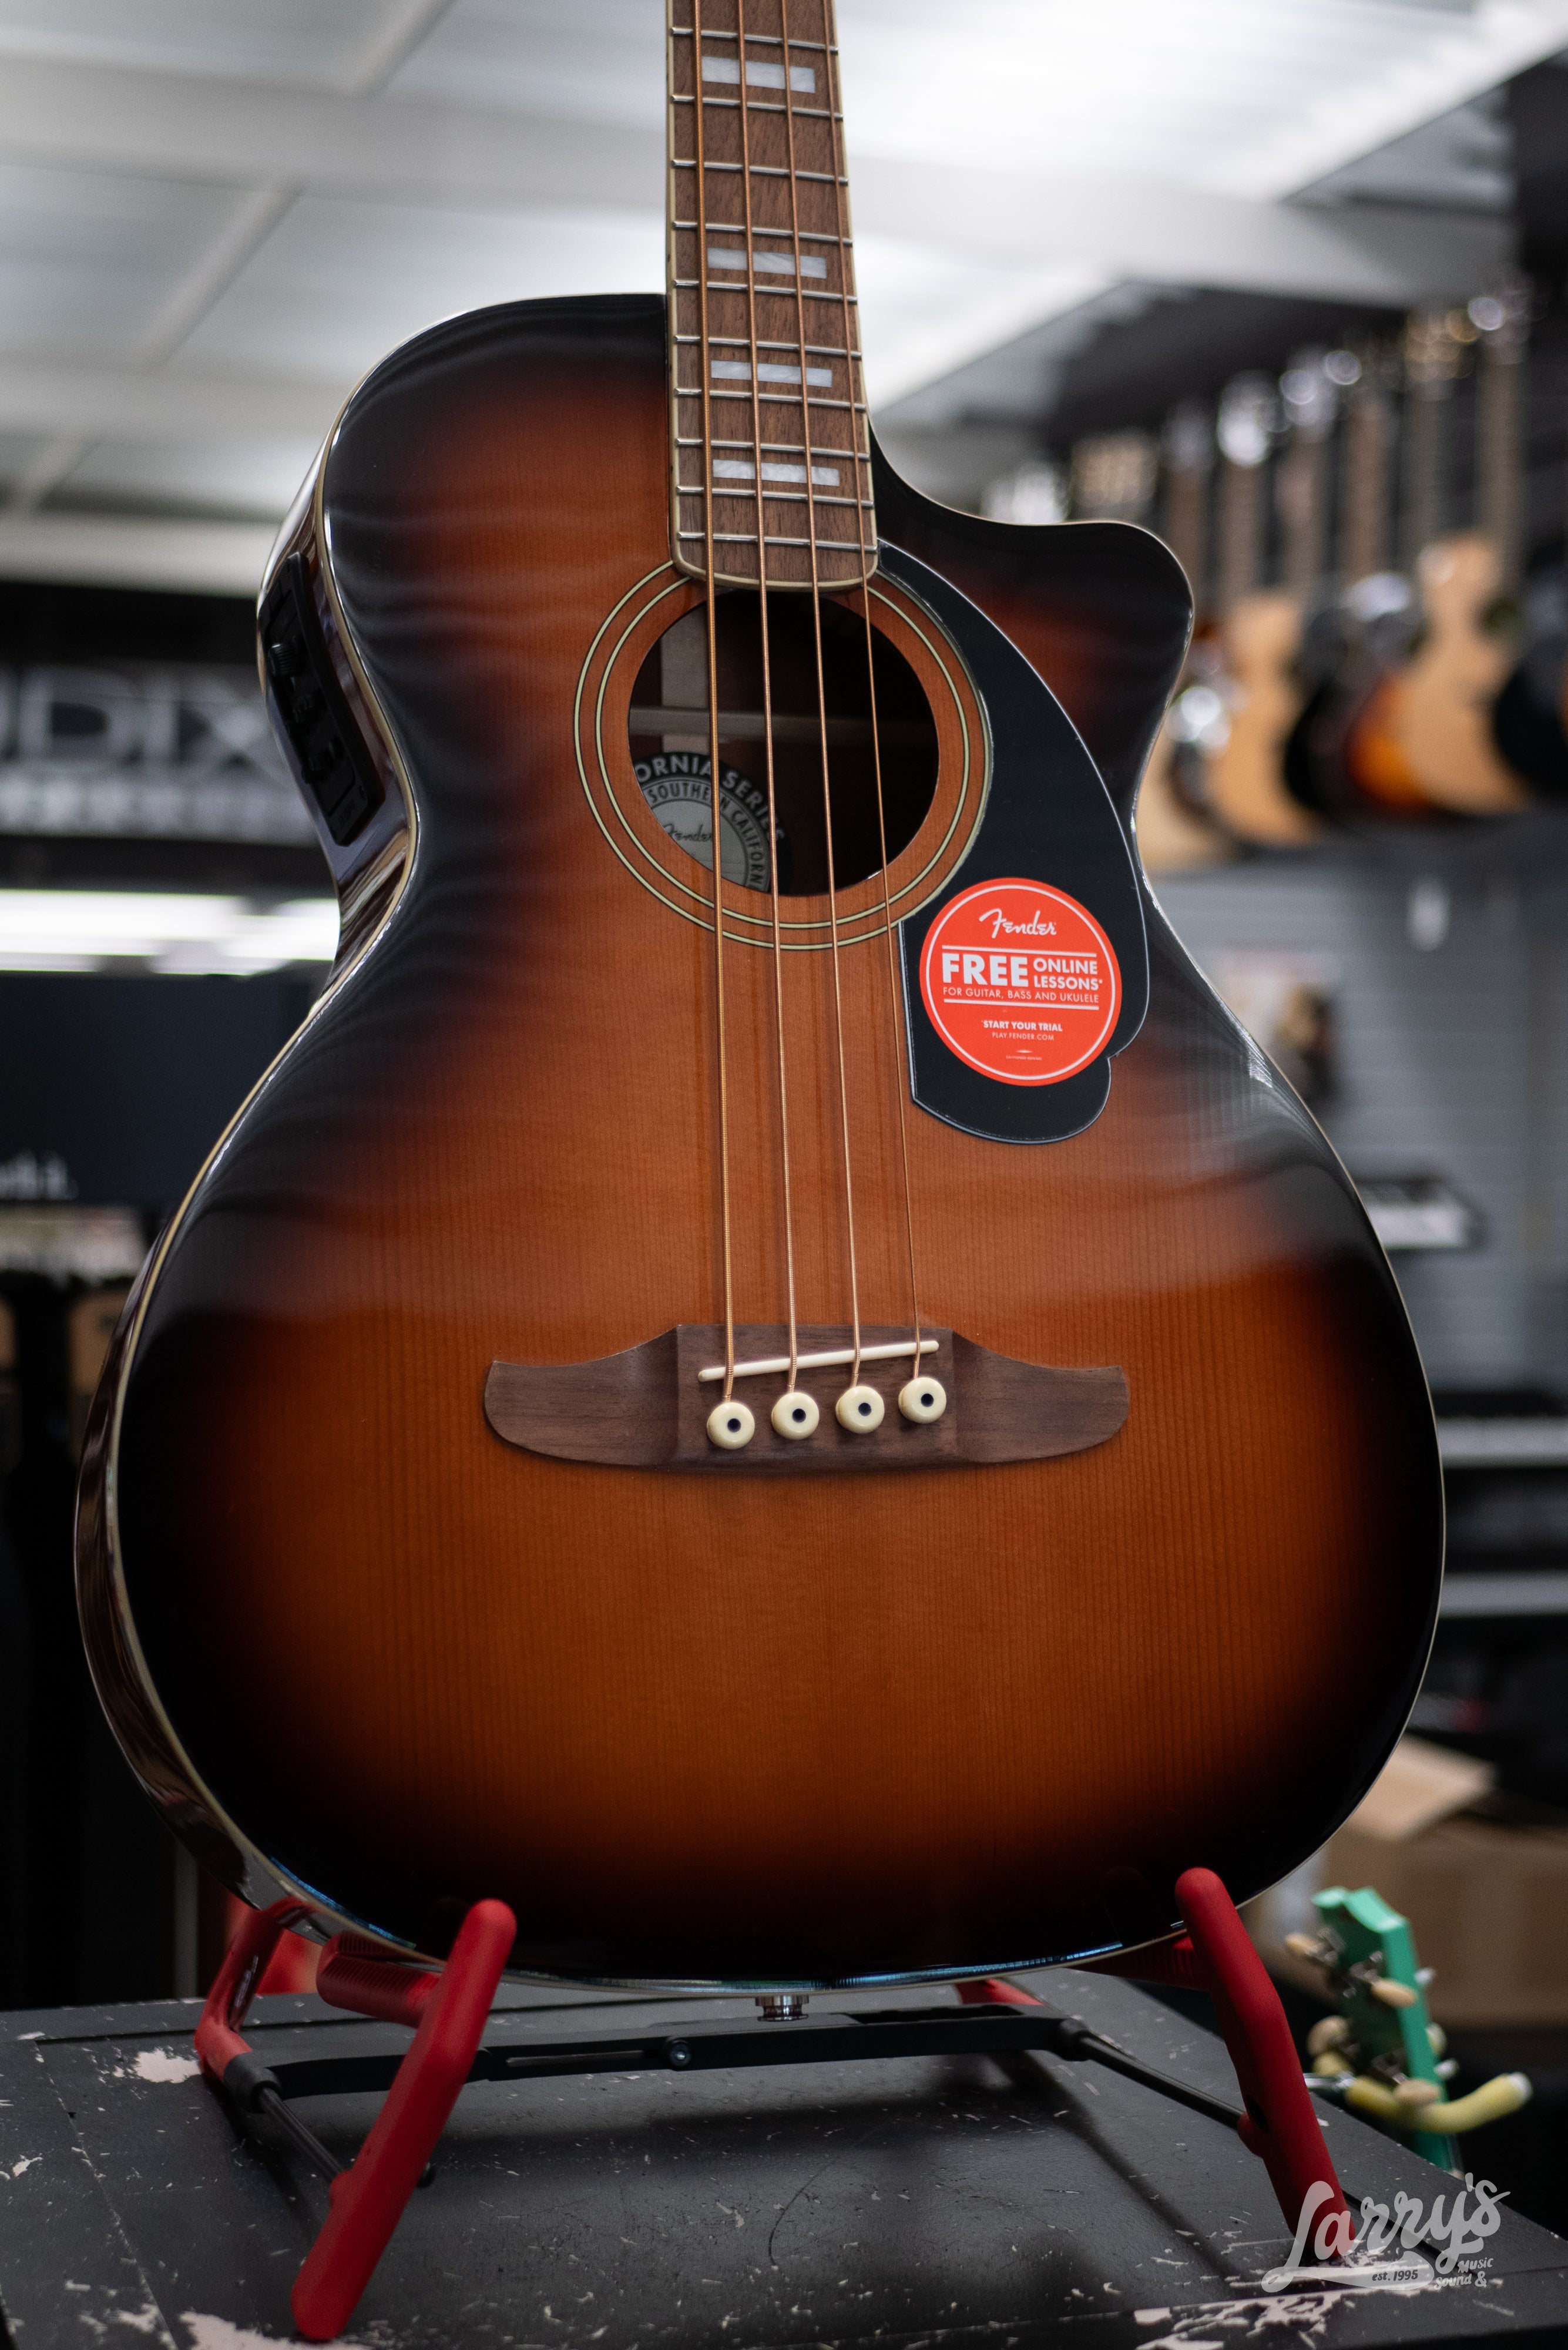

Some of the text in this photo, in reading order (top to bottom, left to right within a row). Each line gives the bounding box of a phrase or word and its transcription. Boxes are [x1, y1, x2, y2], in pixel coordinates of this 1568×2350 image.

[647, 782, 764, 887] SOUTHEN CALIFORN
[663, 822, 713, 842] Fende
[979, 908, 1057, 939] Fender
[942, 953, 1029, 988] FREE
[1033, 958, 1098, 975] ONLINE
[943, 986, 1099, 1003] FOR GUITAR, BASS AND UKULELE
[1011, 1021, 1037, 1030] YOUR
[1038, 1022, 1063, 1032] TRIAL
[992, 1032, 1055, 1041] PLAY.FENDER.COM
